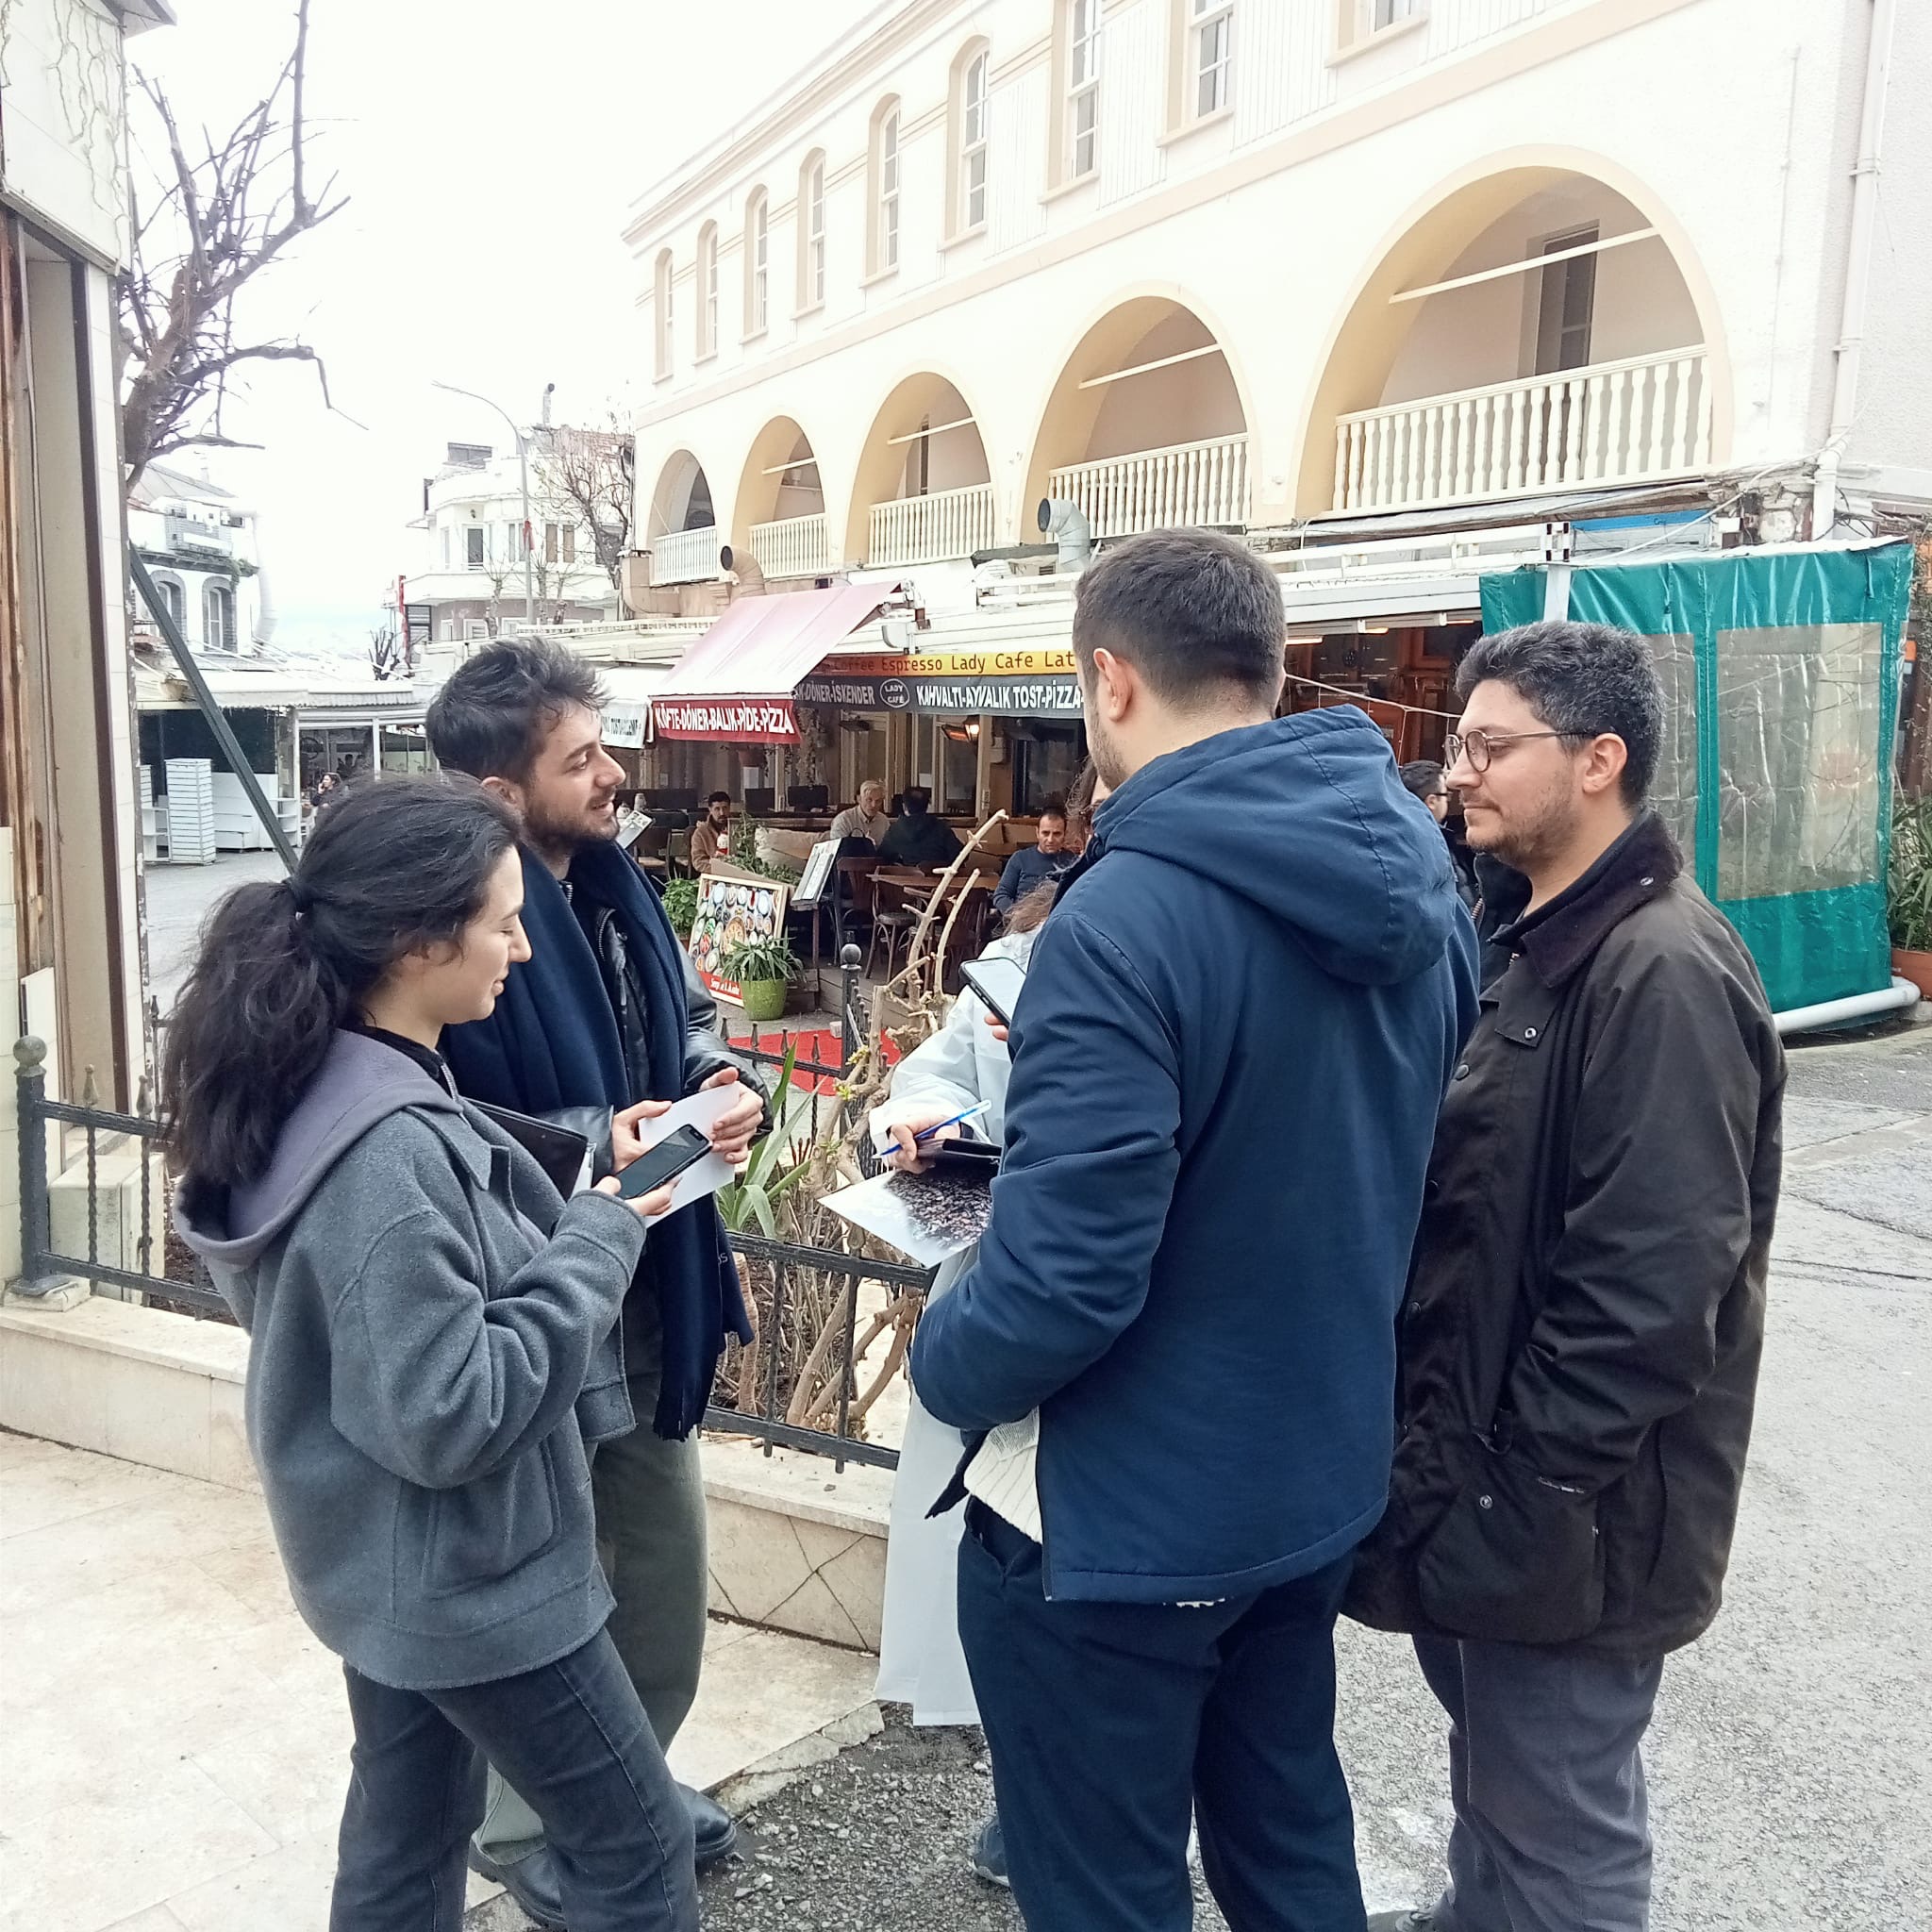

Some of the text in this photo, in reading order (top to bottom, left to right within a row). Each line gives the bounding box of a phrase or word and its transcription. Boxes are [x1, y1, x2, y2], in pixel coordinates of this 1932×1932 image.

[882, 658, 942, 675] Espresso
[951, 654, 986, 674] Lady
[995, 651, 1034, 668] Cafe
[884, 684, 904, 692] LADY
